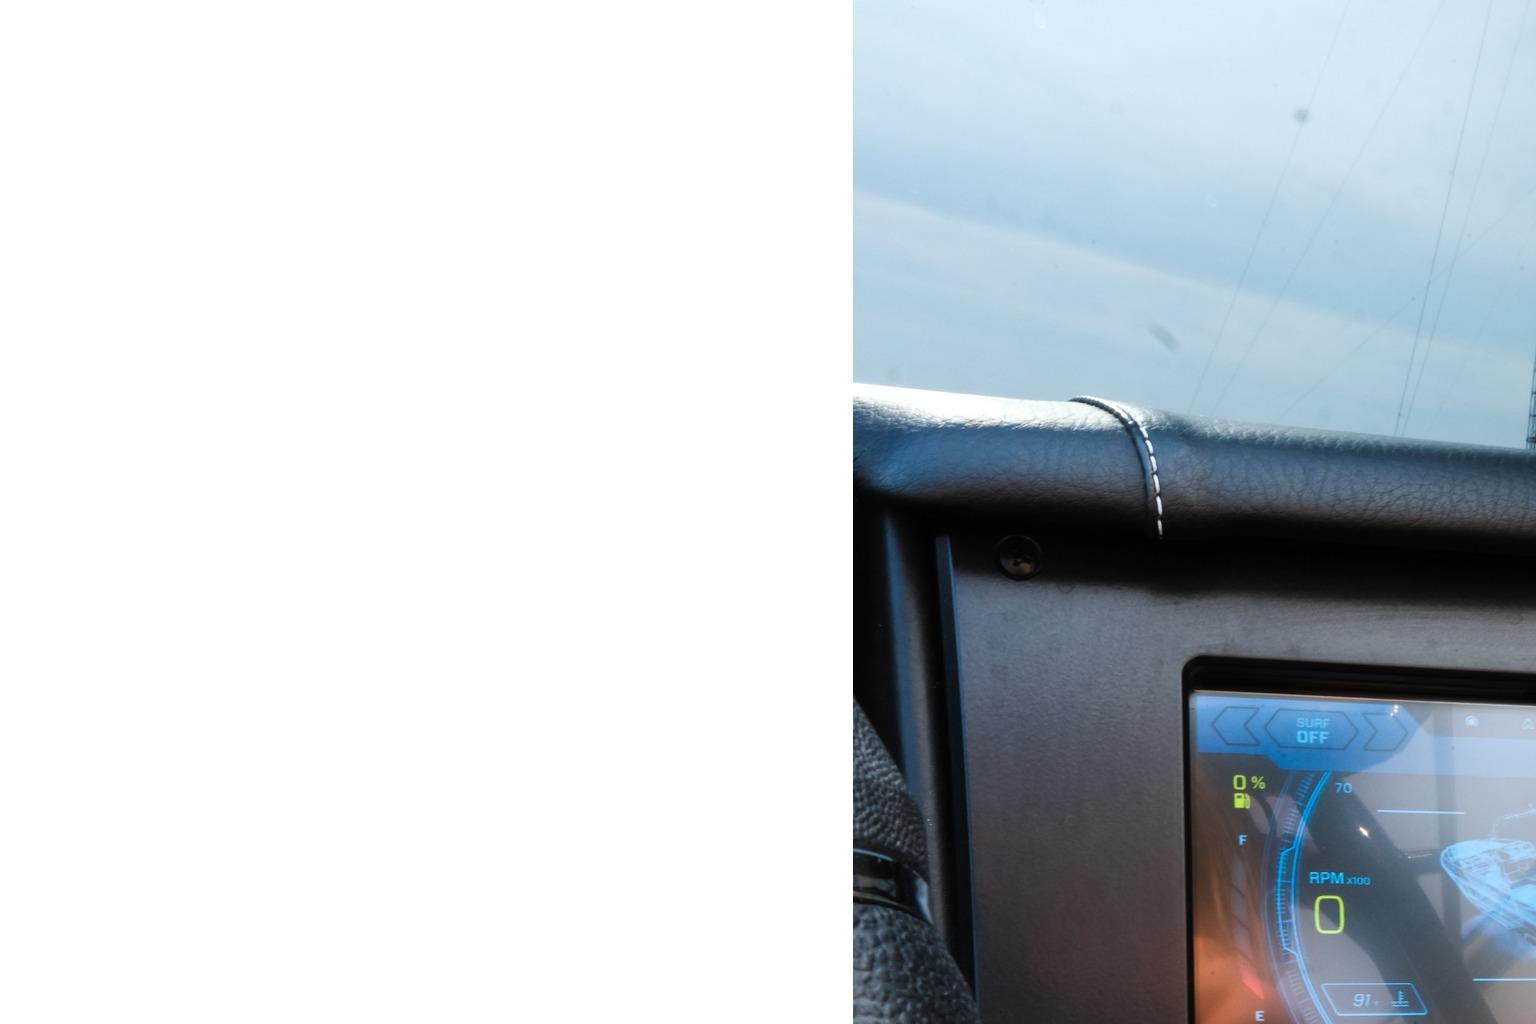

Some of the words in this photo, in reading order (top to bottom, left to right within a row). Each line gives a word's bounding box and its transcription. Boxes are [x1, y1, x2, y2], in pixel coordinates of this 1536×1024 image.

[1296, 717, 1330, 729] SURF
[1296, 730, 1329, 744] OFF
[1232, 774, 1247, 790] 0
[1335, 782, 1353, 794] 70
[1238, 834, 1248, 846] F
[1309, 872, 1345, 885] RPM
[1314, 895, 1345, 935] 0
[1255, 1010, 1265, 1022] E
